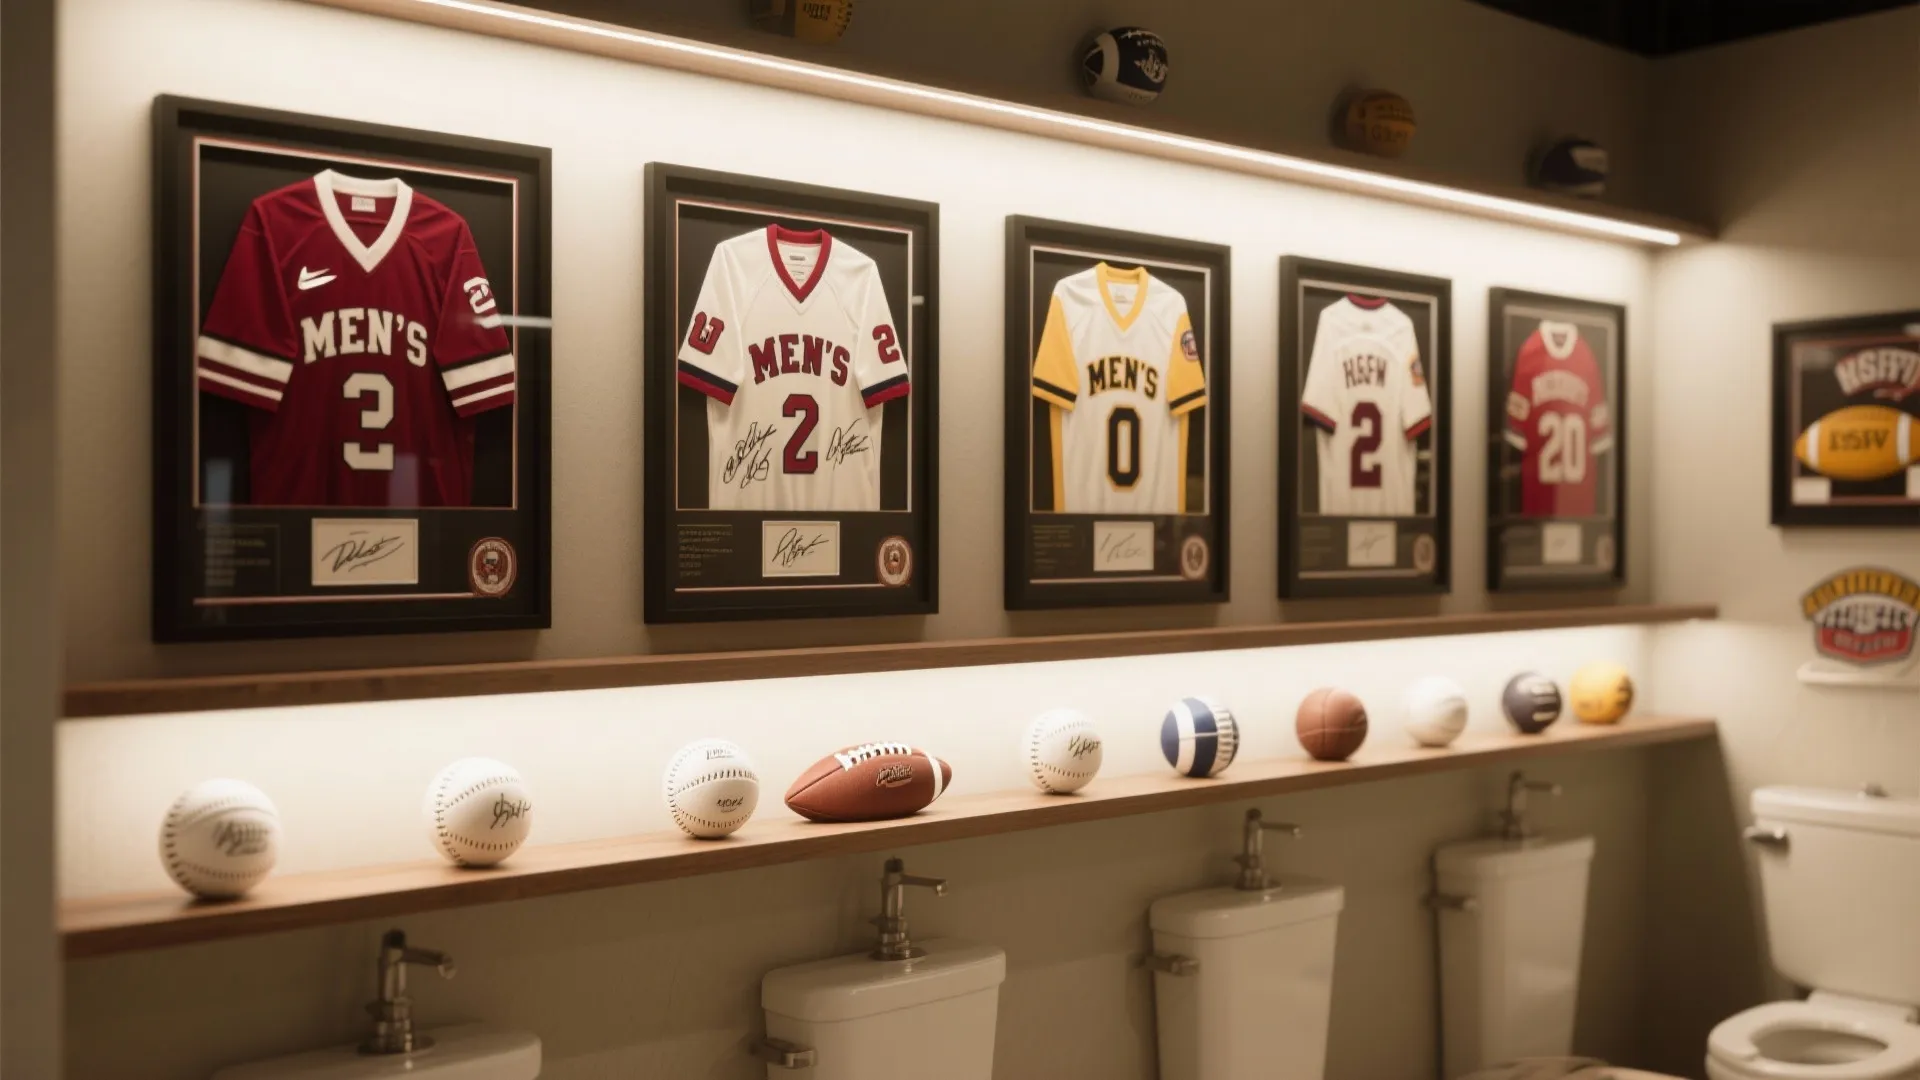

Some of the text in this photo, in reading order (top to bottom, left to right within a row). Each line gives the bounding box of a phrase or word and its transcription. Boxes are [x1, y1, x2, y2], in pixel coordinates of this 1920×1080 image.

[300, 307, 428, 367] MEN'S
[748, 333, 851, 387] MEN'S
[1087, 356, 1159, 401] MEN'S
[782, 393, 820, 475] 2
[1351, 401, 1382, 488] 2
[1538, 410, 1586, 484] 20
